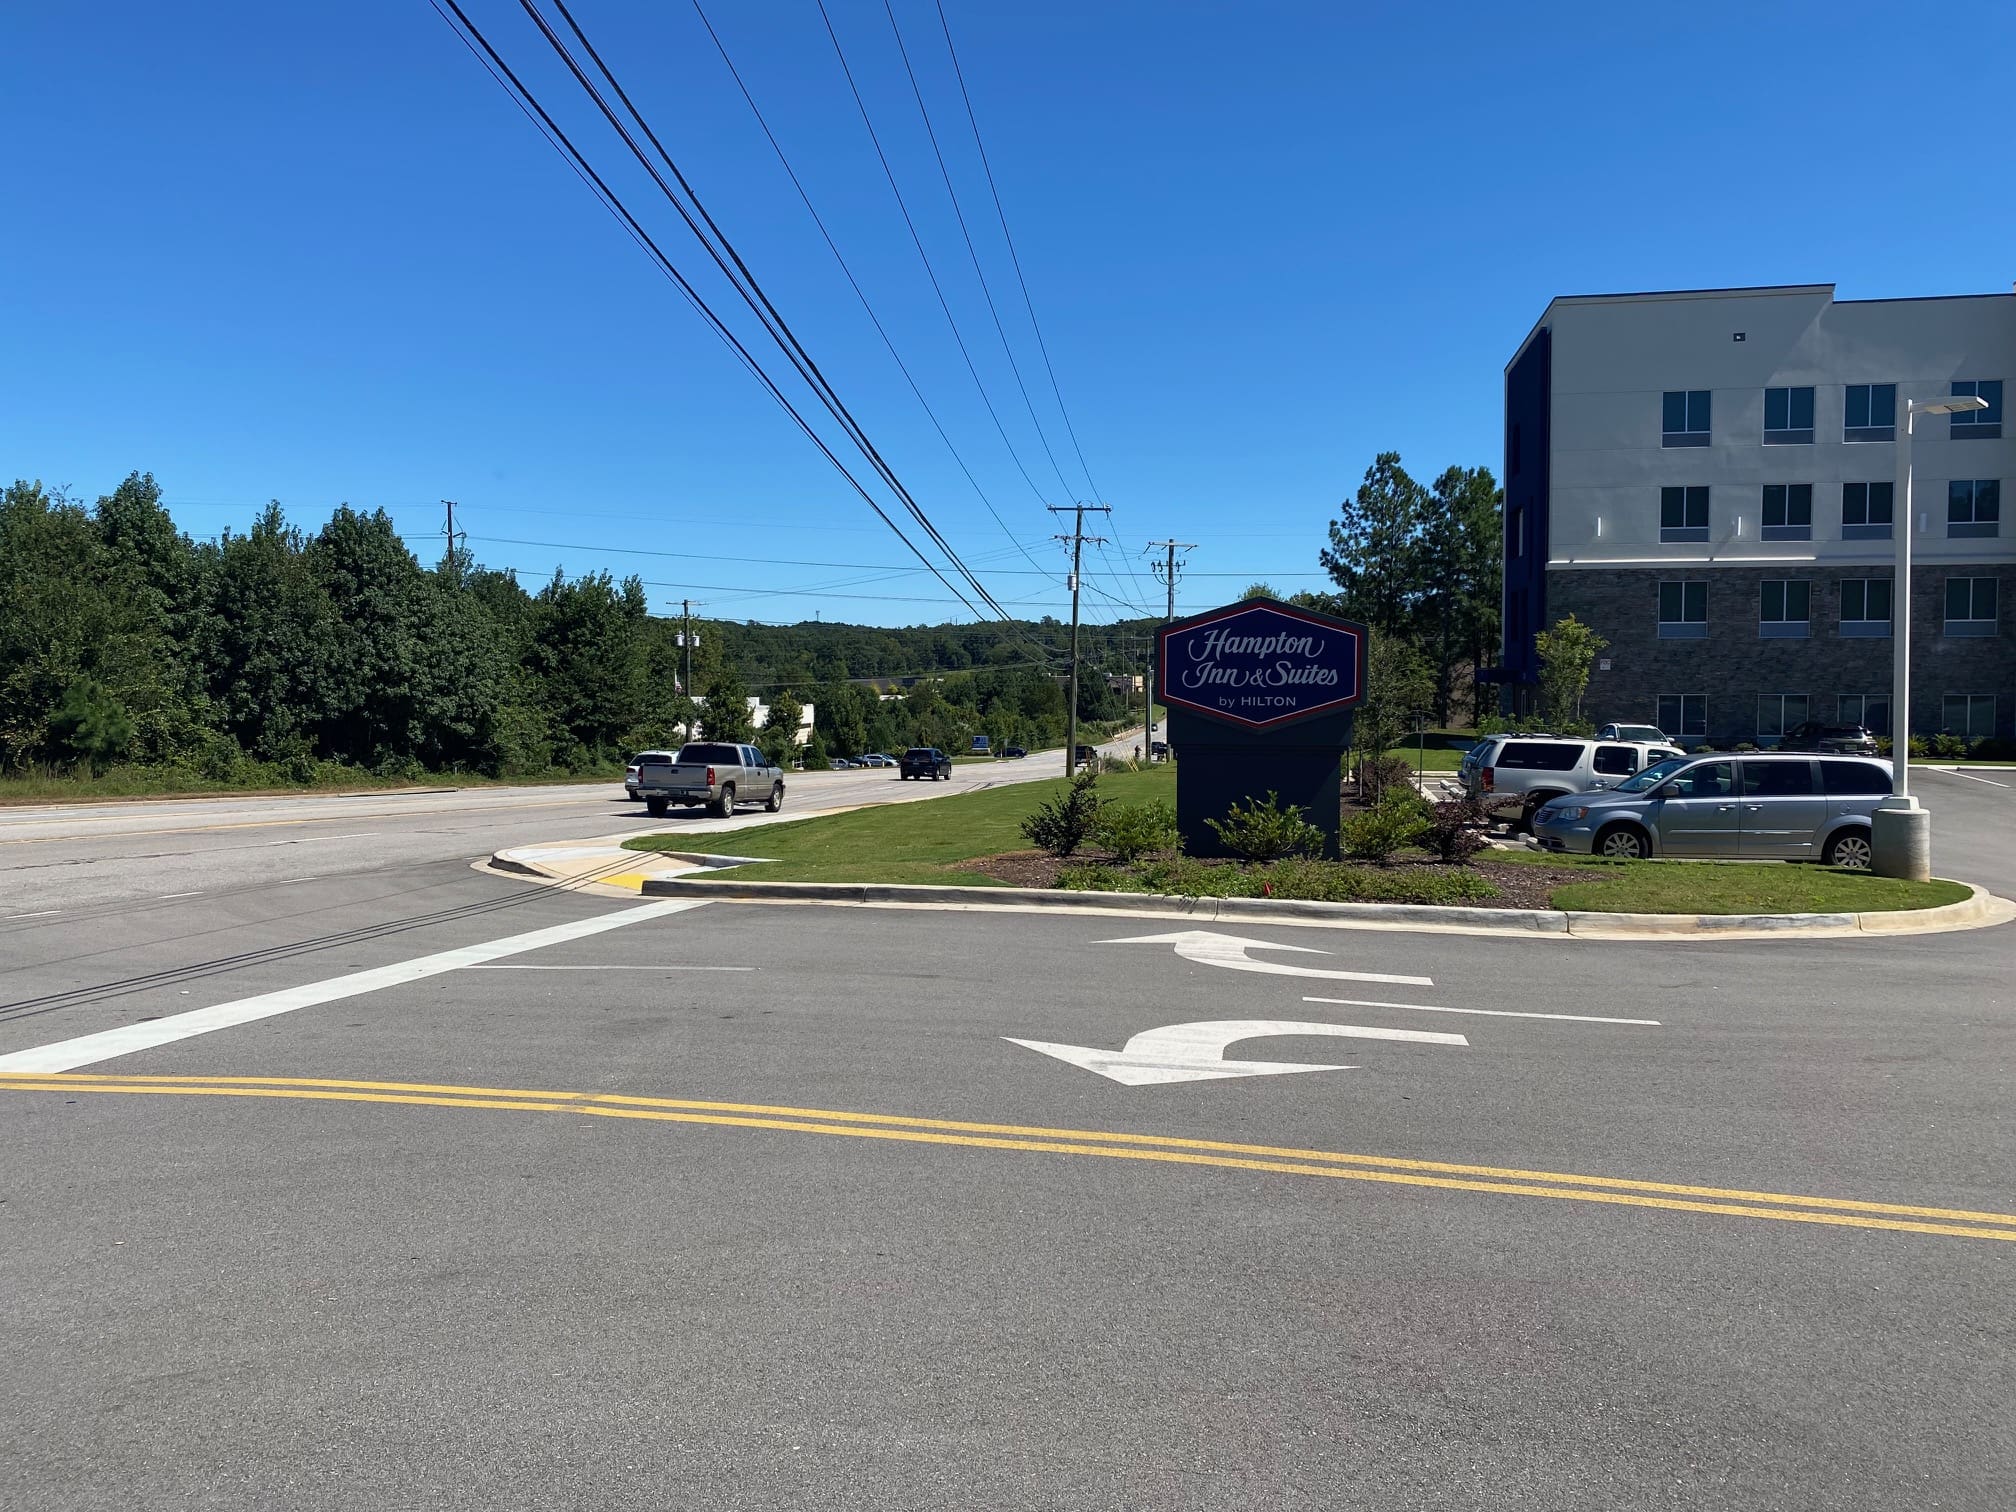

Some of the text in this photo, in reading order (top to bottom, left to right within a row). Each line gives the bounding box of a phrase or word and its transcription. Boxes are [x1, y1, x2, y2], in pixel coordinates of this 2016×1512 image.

[1188, 628, 1325, 662] Hampton
[1182, 660, 1338, 688] Inn & Suites
[1218, 696, 1296, 709] by HILTON
